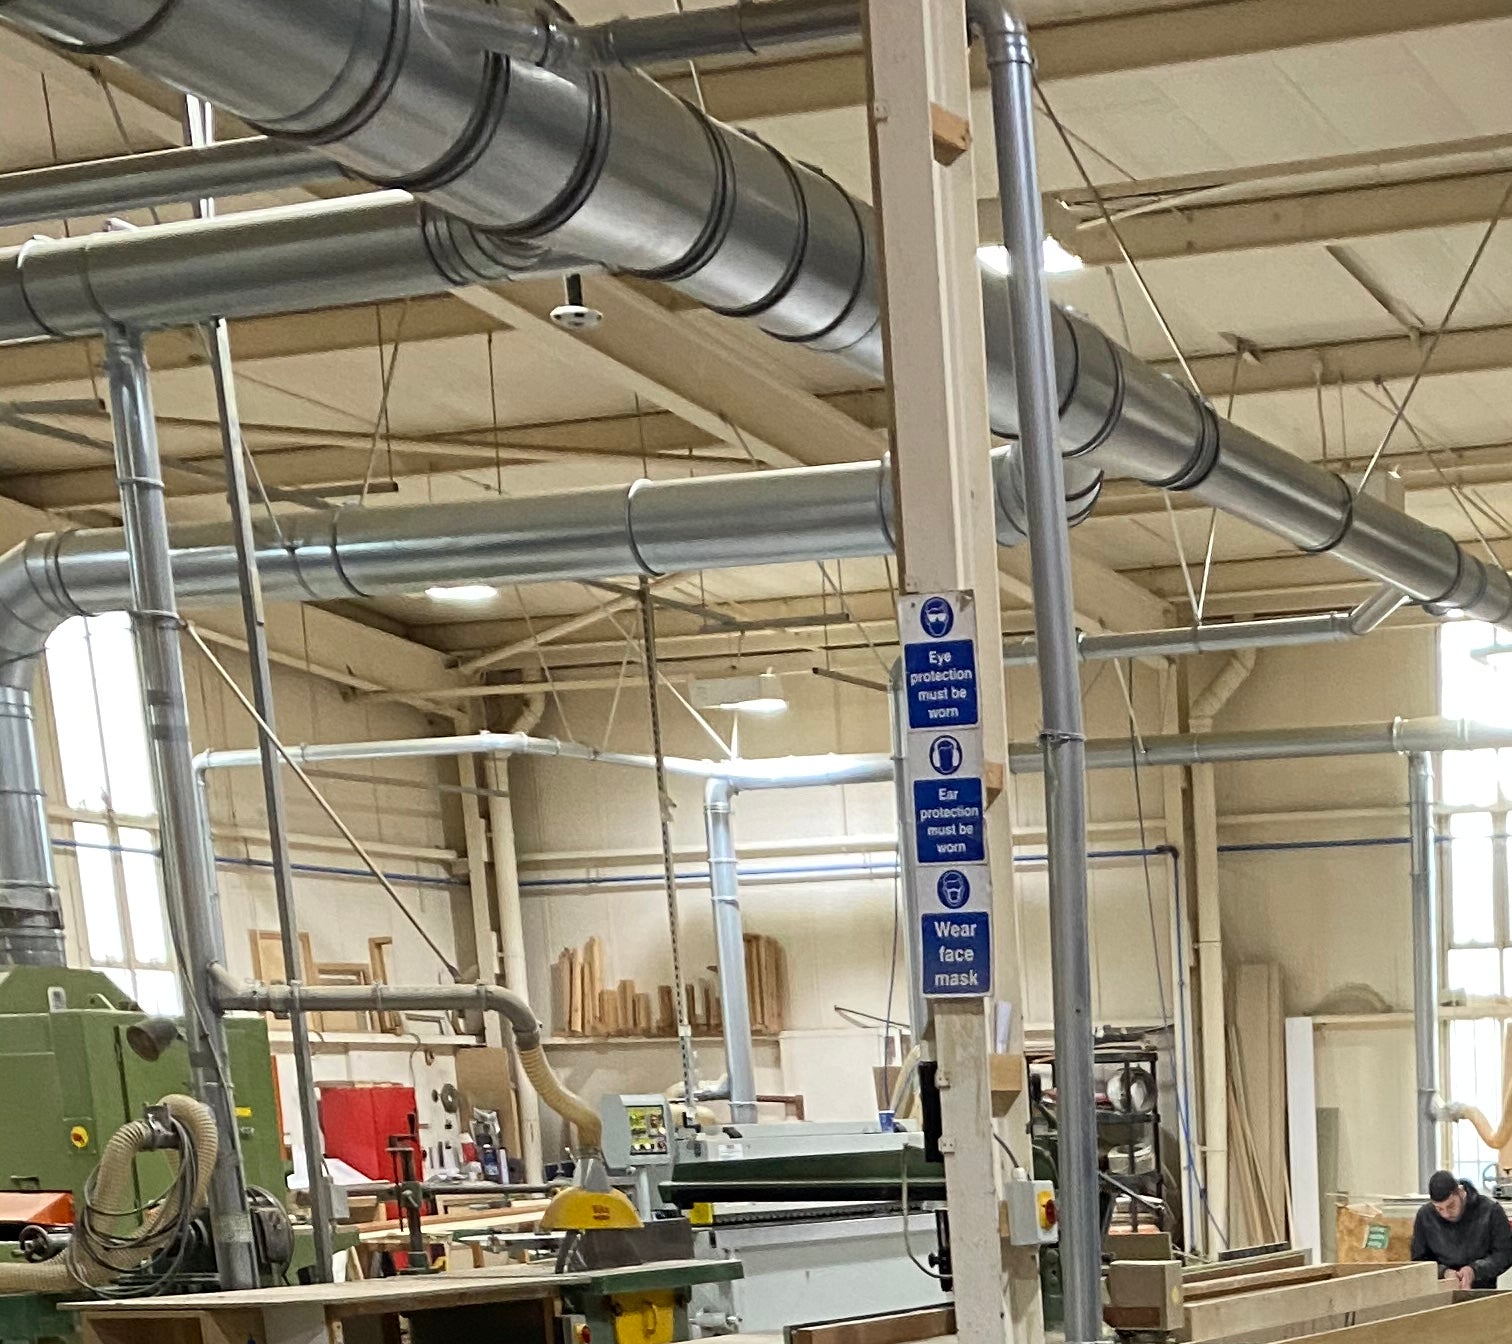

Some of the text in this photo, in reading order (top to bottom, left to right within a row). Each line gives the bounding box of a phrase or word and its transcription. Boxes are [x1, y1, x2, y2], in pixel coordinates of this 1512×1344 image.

[928, 650, 952, 666] Eye
[910, 667, 973, 687] protection
[918, 686, 967, 701] must be
[927, 707, 959, 719] worn
[938, 787, 959, 801] Ear
[920, 805, 979, 822] protection
[927, 822, 974, 836] must be
[936, 842, 967, 853] worn
[933, 921, 977, 938] Wear
[938, 945, 975, 962] face
[934, 969, 979, 986] mask
